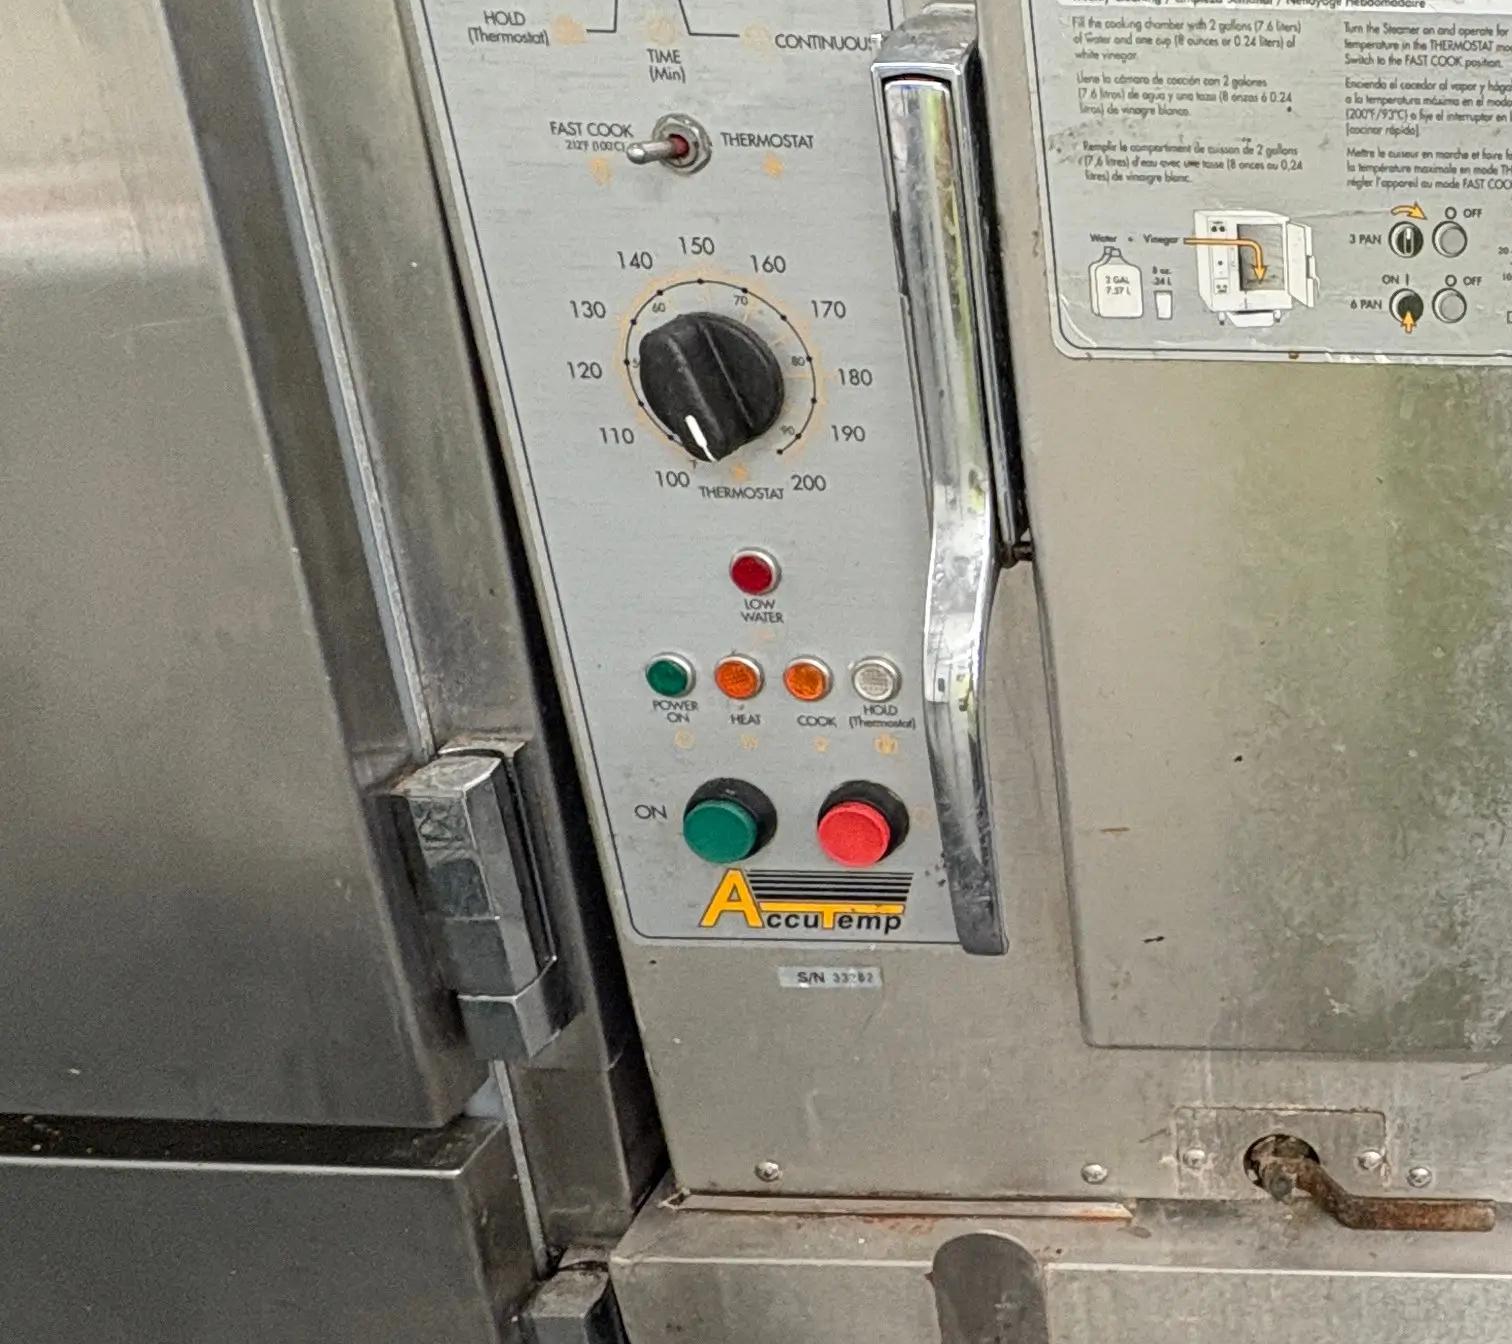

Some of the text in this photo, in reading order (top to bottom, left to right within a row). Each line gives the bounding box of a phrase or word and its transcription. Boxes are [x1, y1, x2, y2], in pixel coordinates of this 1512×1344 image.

[483, 11, 526, 26] HOLD
[468, 26, 550, 46] (Thermostat)
[647, 48, 681, 64] TIME
[649, 66, 686, 83] (Min)
[550, 121, 634, 138] FAST COOK
[720, 132, 813, 149] THERMOSTAT
[679, 237, 715, 256] 150
[617, 251, 653, 270] 140
[750, 255, 786, 273] 160
[570, 300, 606, 319] 130
[811, 300, 846, 319] 170
[567, 362, 602, 379] 120
[838, 368, 873, 386] 180
[600, 427, 634, 444] 110
[831, 425, 865, 442] 190
[655, 471, 690, 488] 100
[791, 474, 826, 491] 200
[698, 486, 784, 500] THERMOSTAT
[744, 598, 775, 610] LOW
[741, 612, 784, 623] WATER
[652, 700, 698, 711] POWER
[863, 700, 898, 716] HOLD
[667, 712, 690, 723] ON
[730, 714, 760, 725] HEAT
[797, 715, 837, 727] COOK
[849, 716, 916, 730] (Thermostat)
[634, 805, 667, 819] ON
[700, 868, 905, 934] AccuTemp
[798, 972, 825, 983] S/N
